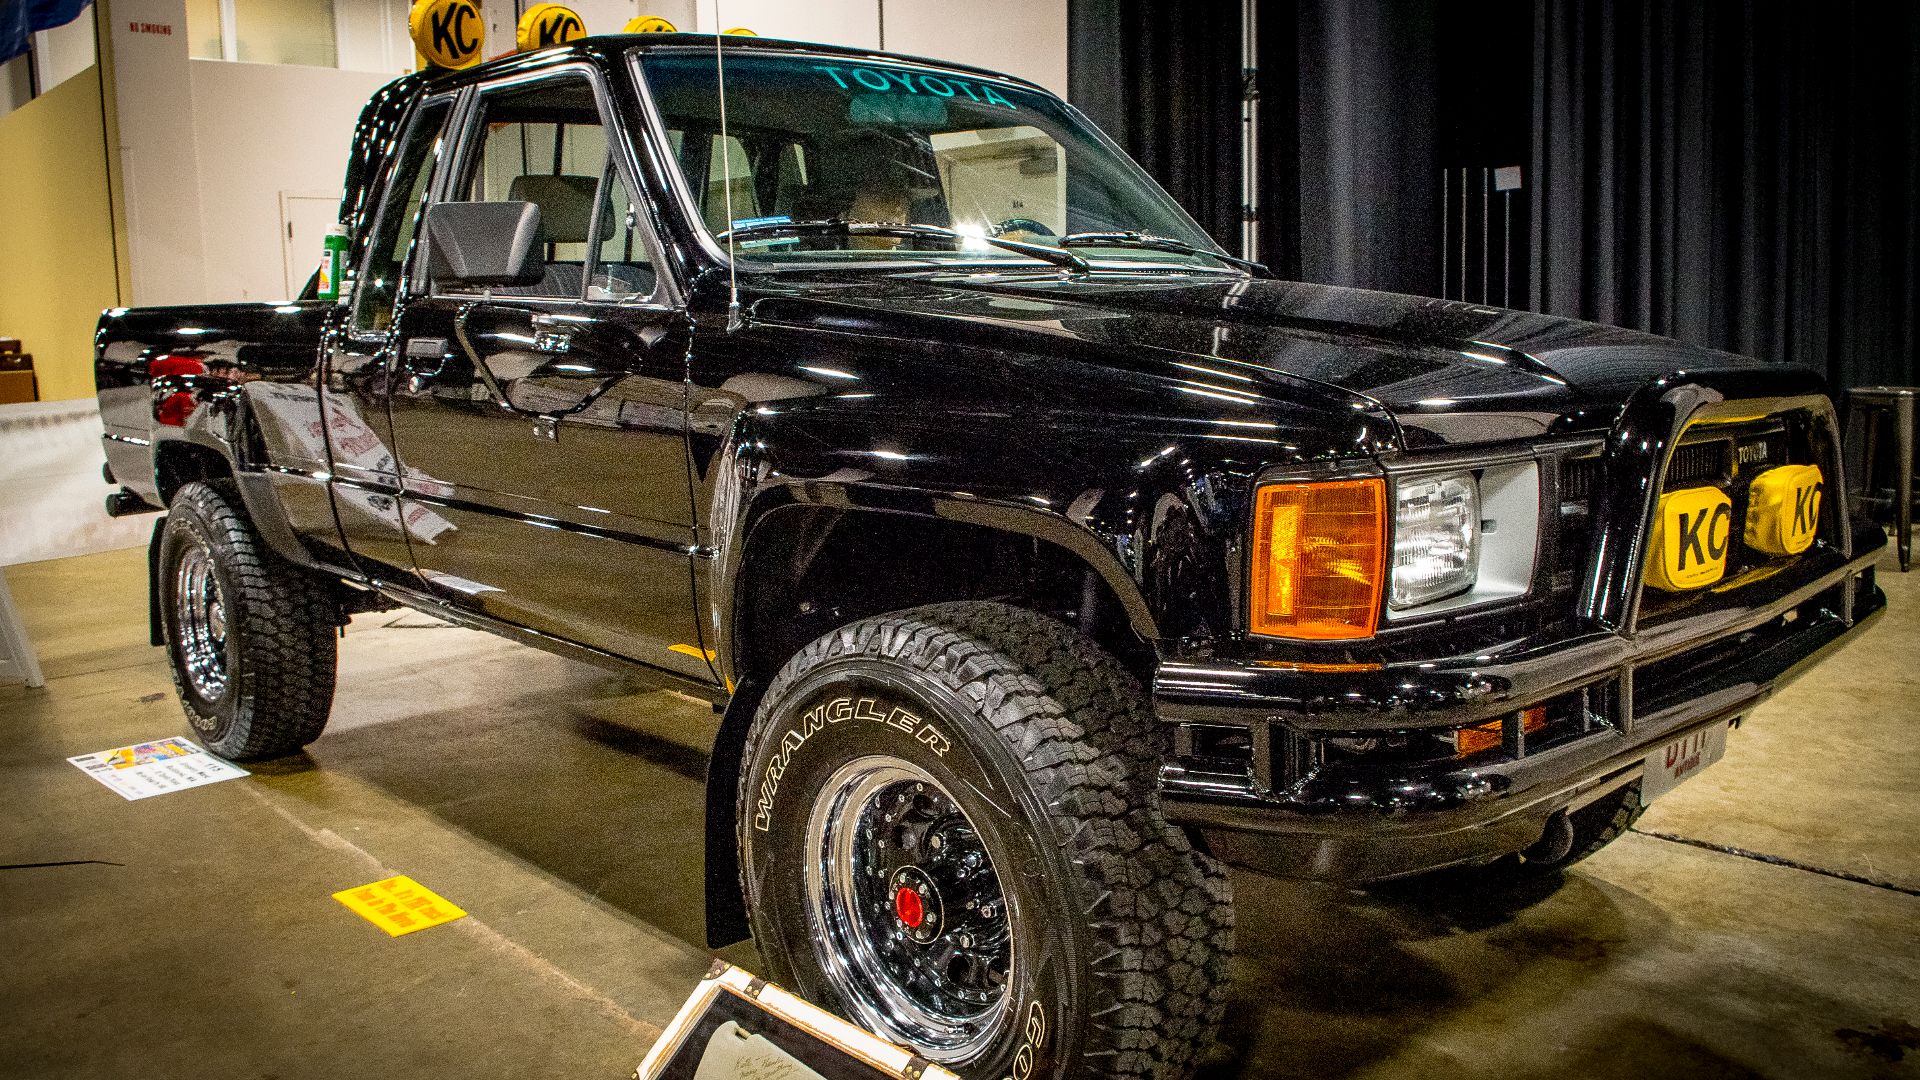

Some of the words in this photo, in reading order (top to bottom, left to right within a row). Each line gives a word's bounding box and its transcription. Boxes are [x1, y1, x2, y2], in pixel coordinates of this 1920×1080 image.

[130, 22, 139, 32] NO
[141, 23, 172, 36] SMOKING
[432, 2, 478, 59] KC
[539, 13, 580, 48] KC
[814, 66, 1017, 110] TOYOTA
[1678, 502, 1731, 571] KC
[1792, 482, 1823, 537] KC
[755, 698, 951, 831] WRANGLER
[1003, 1001, 1045, 1080] GO
